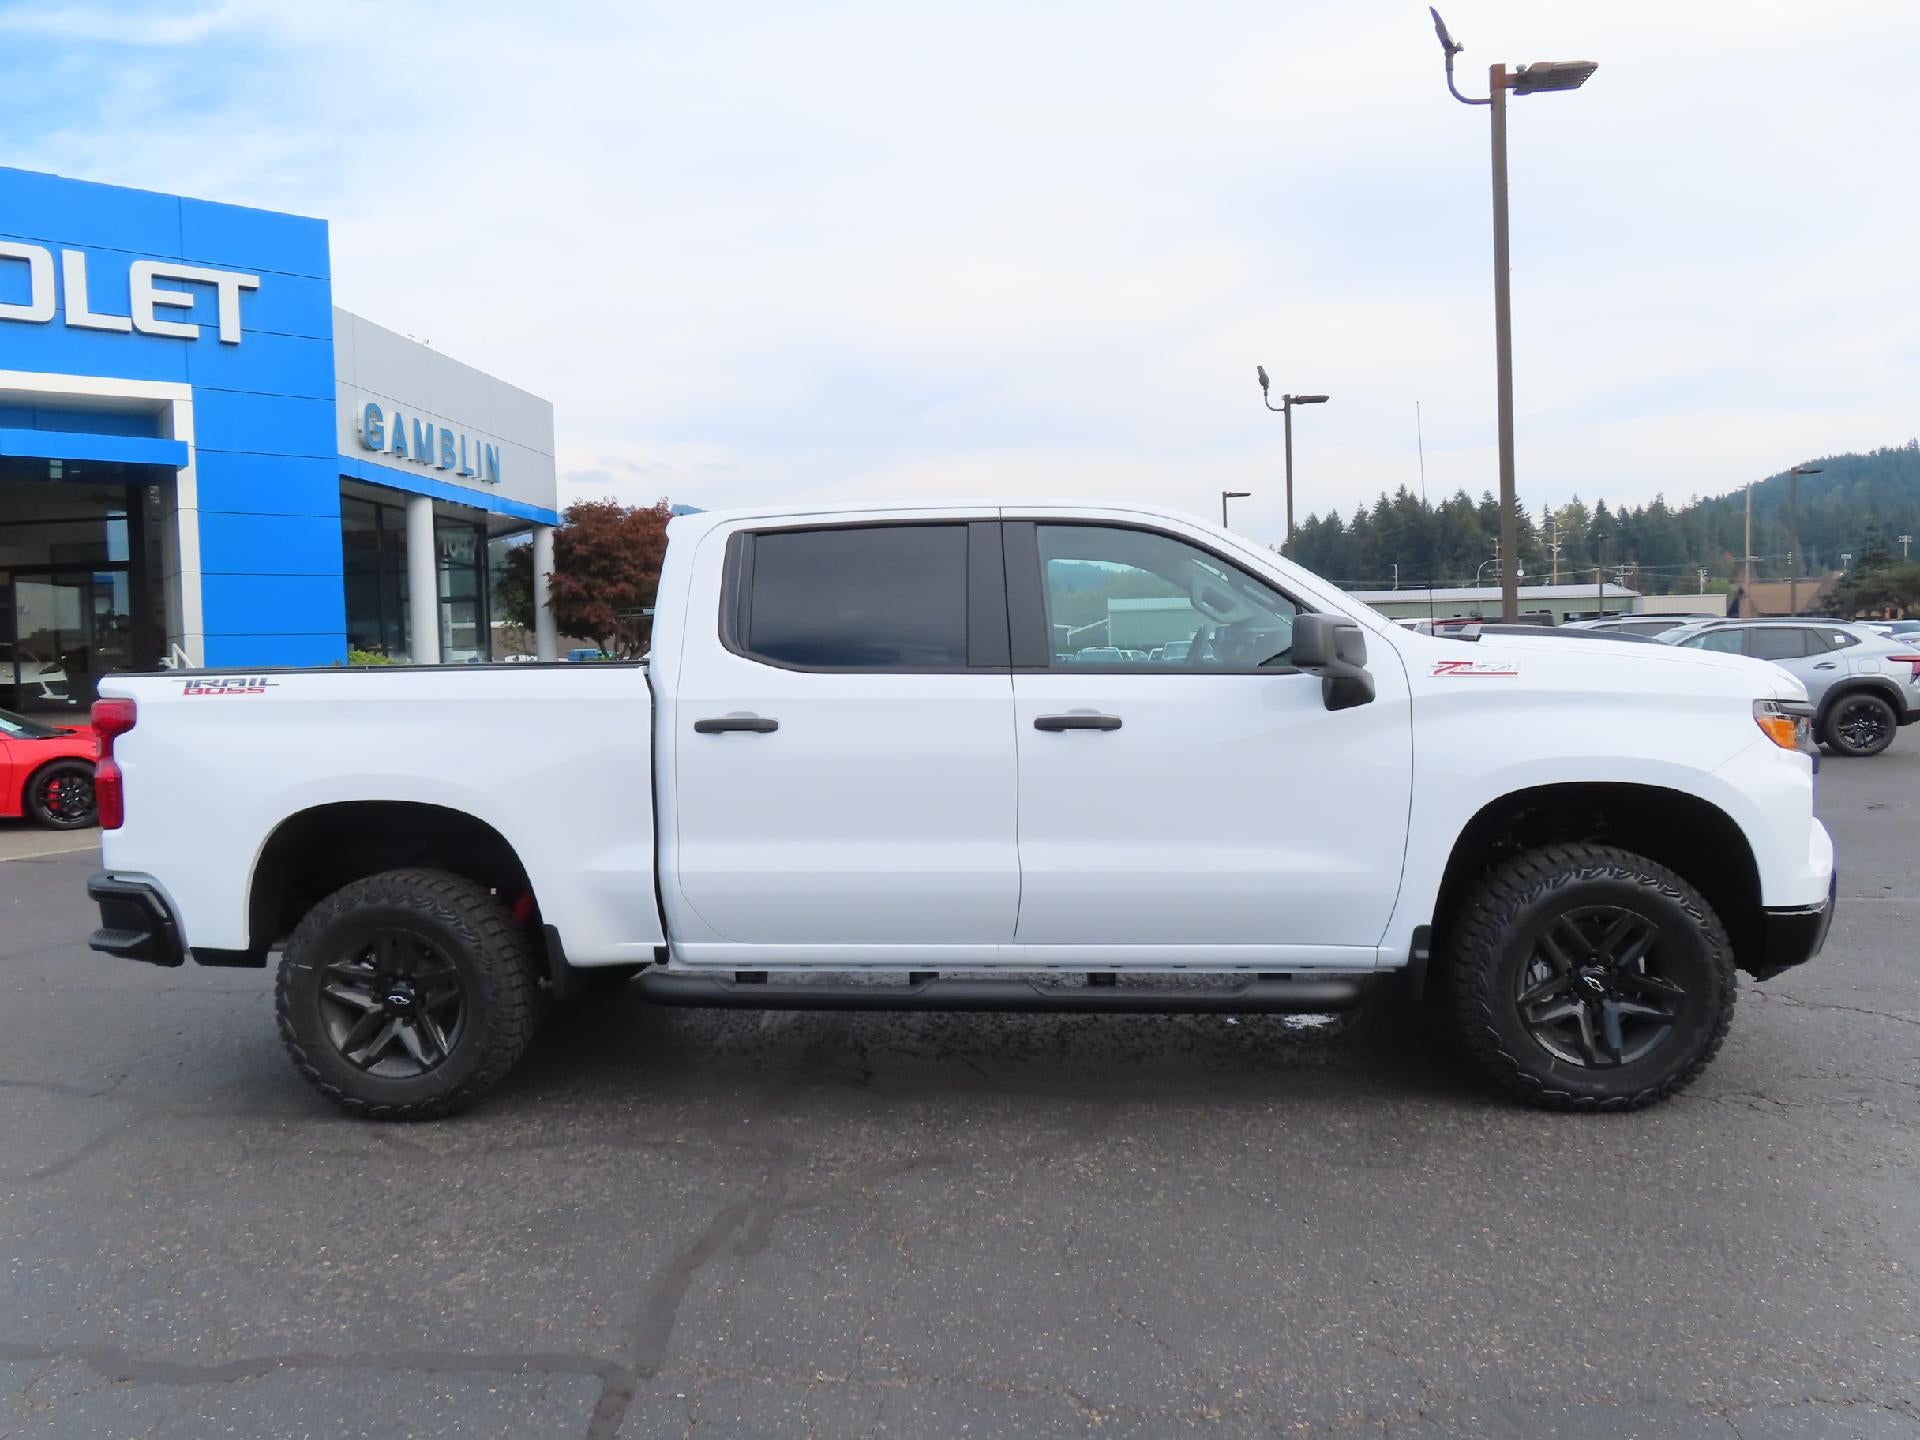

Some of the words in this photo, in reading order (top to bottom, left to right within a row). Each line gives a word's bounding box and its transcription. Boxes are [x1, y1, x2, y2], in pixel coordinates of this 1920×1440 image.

[359, 402, 500, 484] GAMBLIN
[173, 677, 279, 689] TRAIL
[183, 686, 265, 696] BOSS
